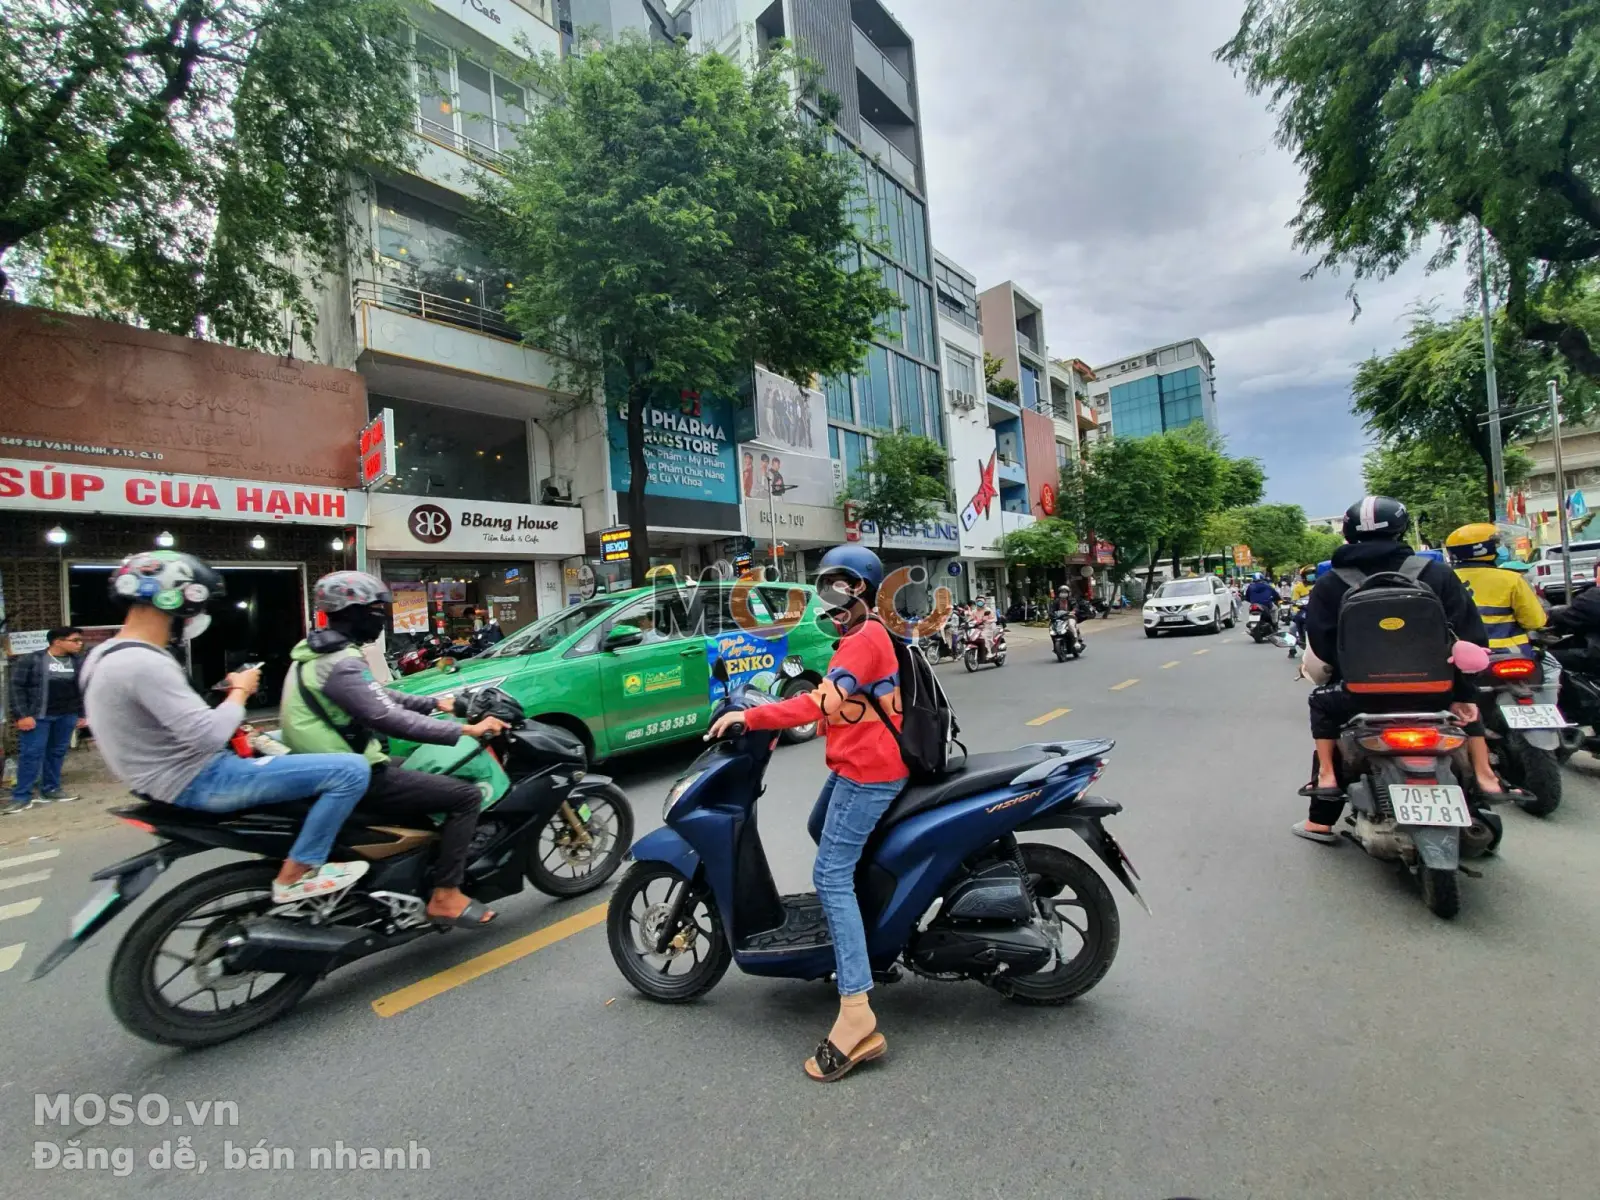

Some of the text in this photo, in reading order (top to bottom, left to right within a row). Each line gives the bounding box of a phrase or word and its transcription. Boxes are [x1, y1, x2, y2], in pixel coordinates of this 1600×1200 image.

[651, 410, 726, 441] PHARMA
[643, 429, 719, 456] RUGSTORE
[0, 465, 345, 519] SÚP CUA HẠNH
[681, 476, 703, 487] Khoa
[461, 512, 559, 531] BBang House
[605, 540, 628, 553] BEYOU
[725, 654, 775, 675] ENKO
[645, 723, 658, 736] 38
[659, 720, 671, 734] 38
[672, 716, 684, 729] 38
[685, 712, 697, 725] 38
[985, 790, 1042, 814] VISION
[1402, 788, 1451, 805] 70-F1
[1400, 805, 1465, 823] 857.81
